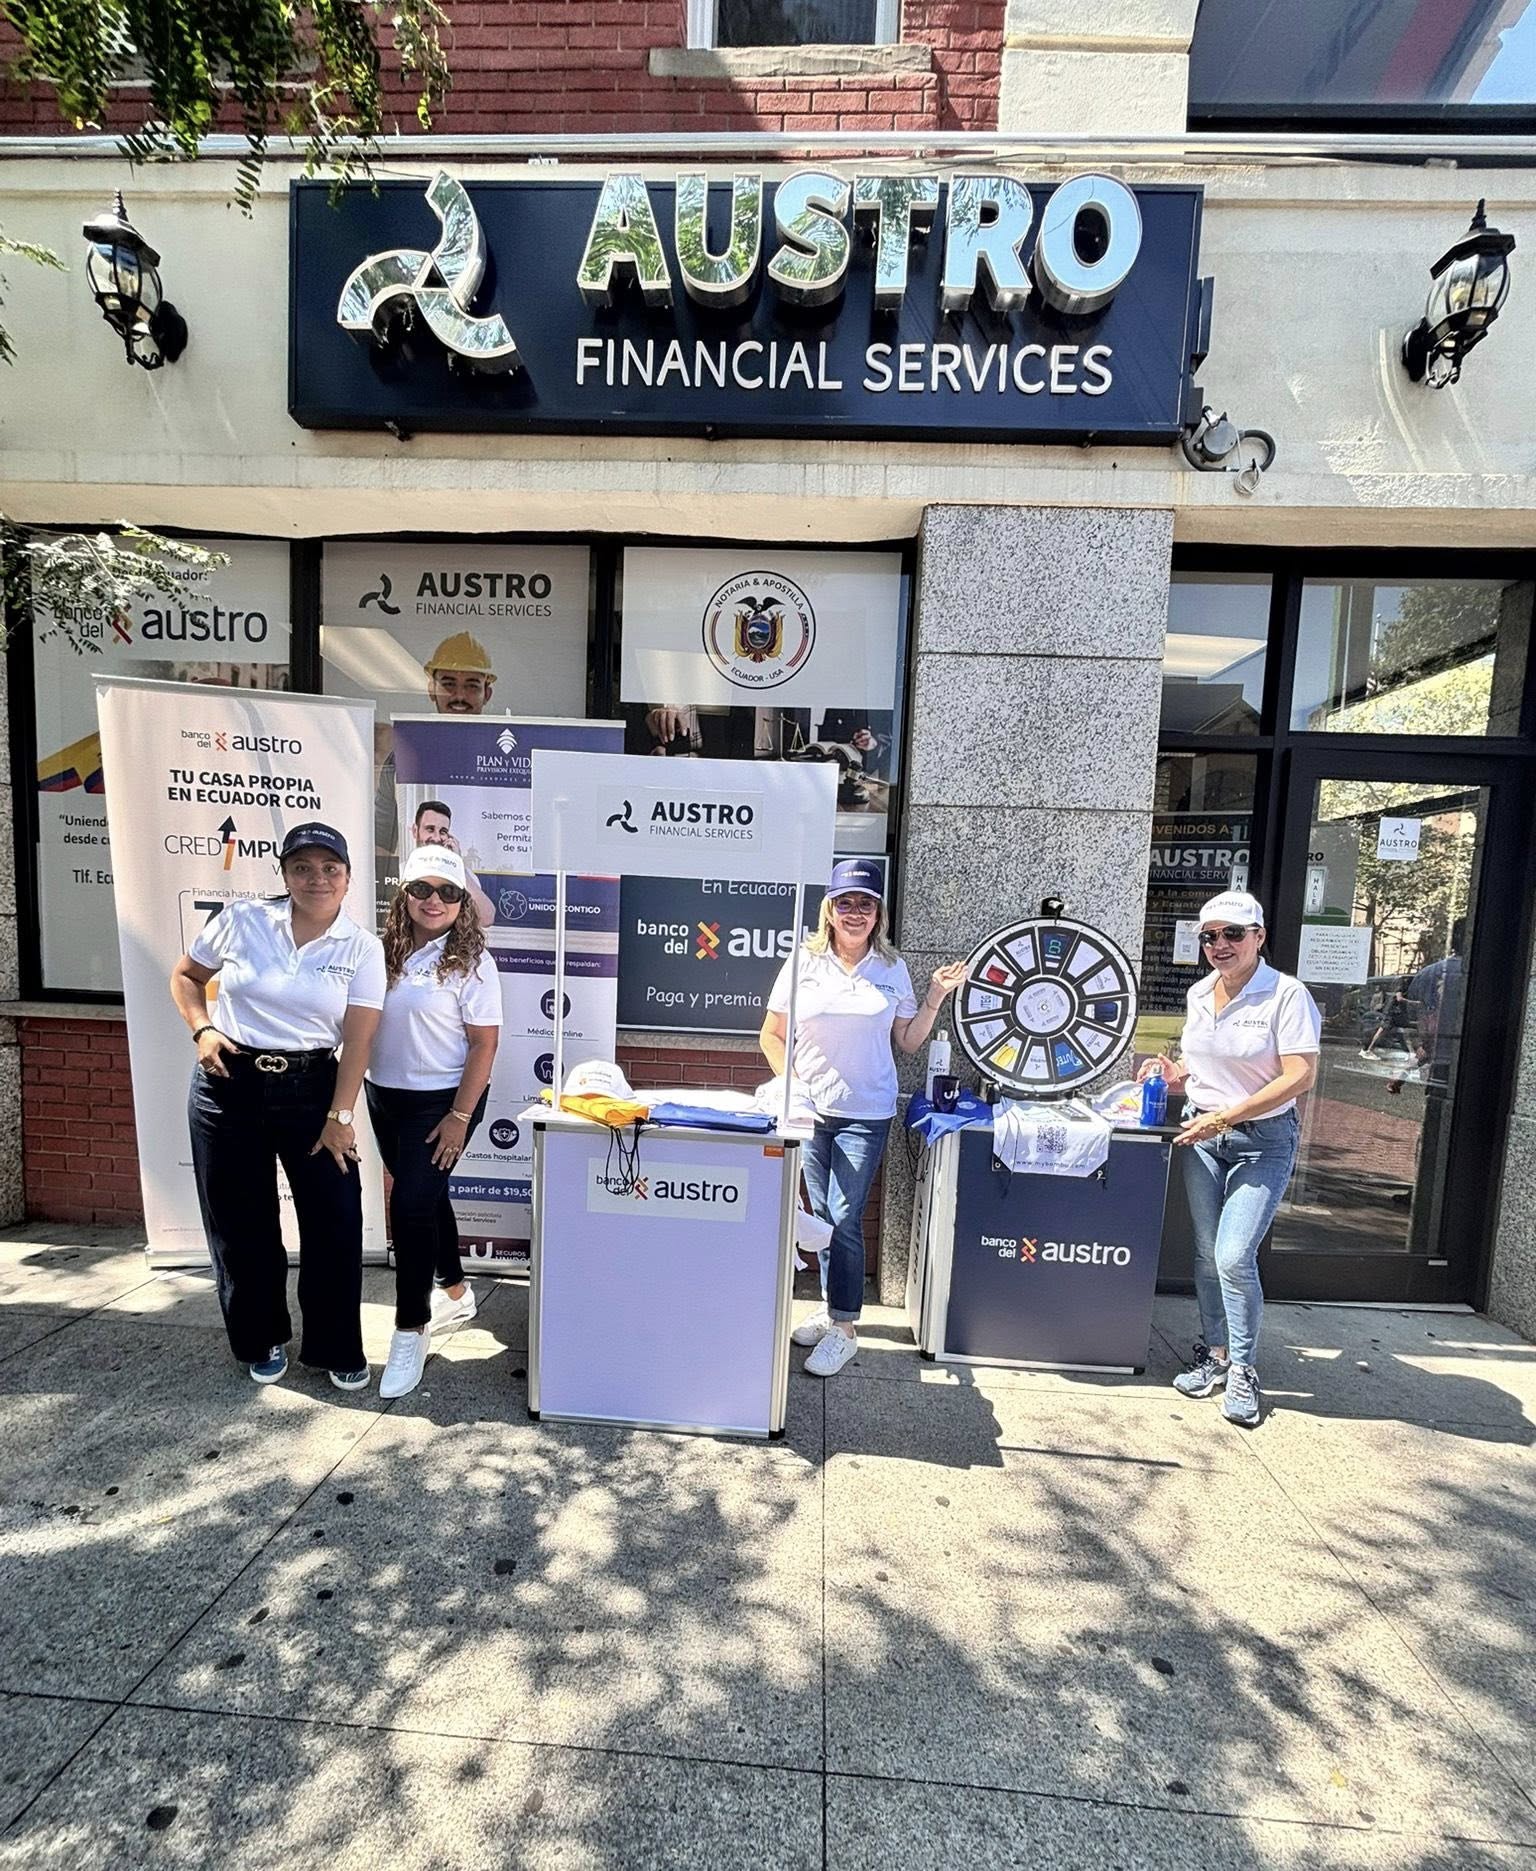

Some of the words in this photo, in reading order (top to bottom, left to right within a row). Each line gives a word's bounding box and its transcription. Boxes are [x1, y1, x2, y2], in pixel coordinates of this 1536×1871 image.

[578, 172, 1143, 305] AUSTRO
[576, 337, 843, 391] FINANCIAL
[862, 342, 1114, 396] SERVICES
[416, 572, 552, 599] AUSTRO
[715, 580, 751, 608] NOTARIA
[752, 577, 760, 586] &
[762, 578, 804, 610] APOSTILLA
[415, 602, 485, 616] FINANCIAL
[488, 603, 552, 617] SERVICES
[80, 622, 104, 638] del
[141, 605, 268, 643] austro
[731, 666, 764, 682] ECUADOR
[769, 668, 784, 680] USA
[181, 729, 211, 740] banco
[196, 739, 212, 748] del
[232, 735, 303, 755] austro
[476, 755, 503, 767] PLAN
[511, 756, 531, 768] VID
[170, 769, 194, 785] TU
[199, 771, 245, 788] CASA
[249, 774, 315, 793] PROPIA
[167, 787, 192, 802] EN
[196, 788, 281, 808] ECUADOR
[284, 795, 322, 810] CON
[59, 814, 110, 827] “Uniend
[481, 811, 524, 821] Sabemos
[651, 801, 754, 826] AUSTRO
[514, 824, 530, 833] por
[649, 825, 702, 838] FINANCIAL
[704, 829, 753, 840] SERVICES
[63, 832, 98, 845] desde
[1379, 838, 1418, 848] AUSTRO
[502, 844, 515, 852] de
[516, 845, 528, 853] su
[72, 868, 93, 884] Tlf.
[384, 876, 400, 886] PR
[1149, 868, 1198, 879] INANCIAL
[1199, 870, 1231, 880] SERV
[192, 887, 230, 898] Financia
[232, 889, 256, 899] hasta
[702, 879, 722, 894] En
[728, 880, 797, 896] Ecuador
[528, 903, 557, 912] UNIDO
[637, 918, 689, 937] banco
[664, 938, 689, 955] del
[728, 925, 809, 959] aus
[510, 956, 545, 965] beneficios
[328, 964, 356, 976] AUSTRO
[646, 986, 685, 1007] Paga
[689, 992, 700, 1008] y
[704, 992, 763, 1009] premia
[562, 1030, 583, 1038] nline
[465, 1151, 492, 1160] Gastos
[596, 1175, 630, 1187] banco
[458, 1185, 486, 1195] partir
[487, 1186, 501, 1196] de
[653, 1180, 739, 1204] austro
[981, 1235, 1017, 1248] banco
[495, 1249, 527, 1258] SEGUROS
[998, 1247, 1017, 1259] del
[1041, 1241, 1132, 1267] austro
